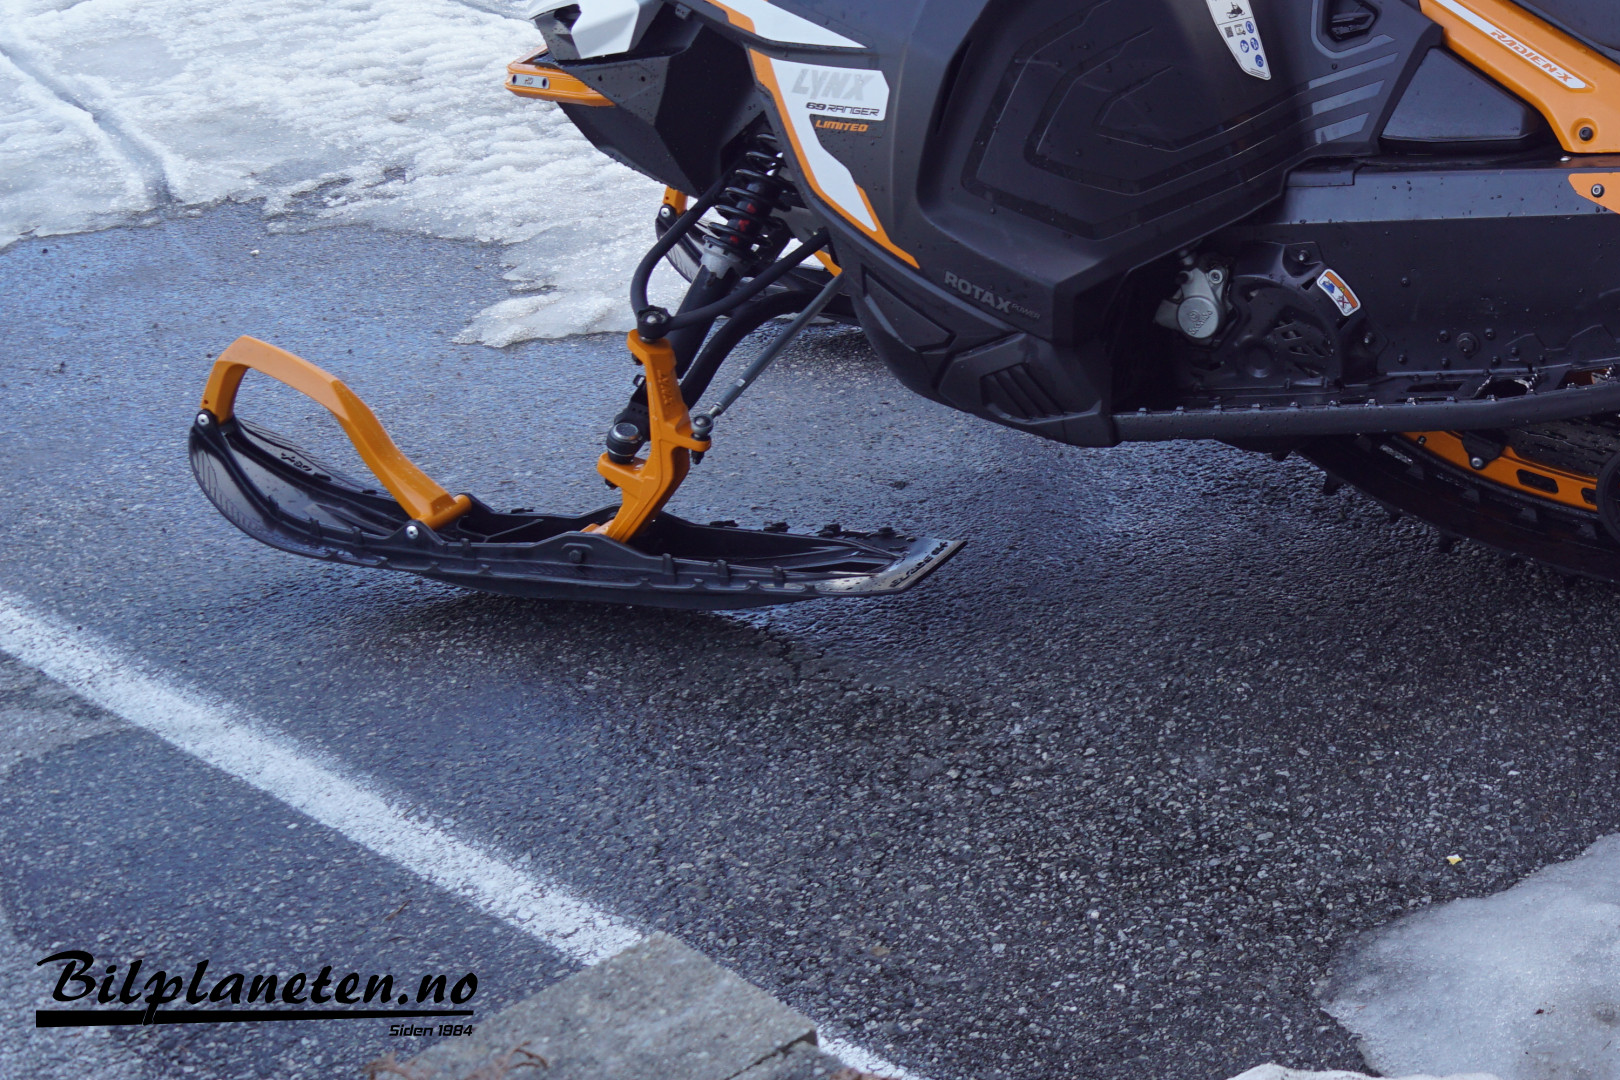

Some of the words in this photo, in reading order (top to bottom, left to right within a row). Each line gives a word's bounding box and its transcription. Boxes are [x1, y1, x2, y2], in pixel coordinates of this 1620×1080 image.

[1490, 29, 1574, 83] RADIEN-X
[791, 68, 876, 101] LYNX
[805, 101, 827, 111] 69
[827, 104, 880, 117] RANGER
[815, 119, 870, 133] LIMITED
[944, 270, 1012, 314] ROTAX
